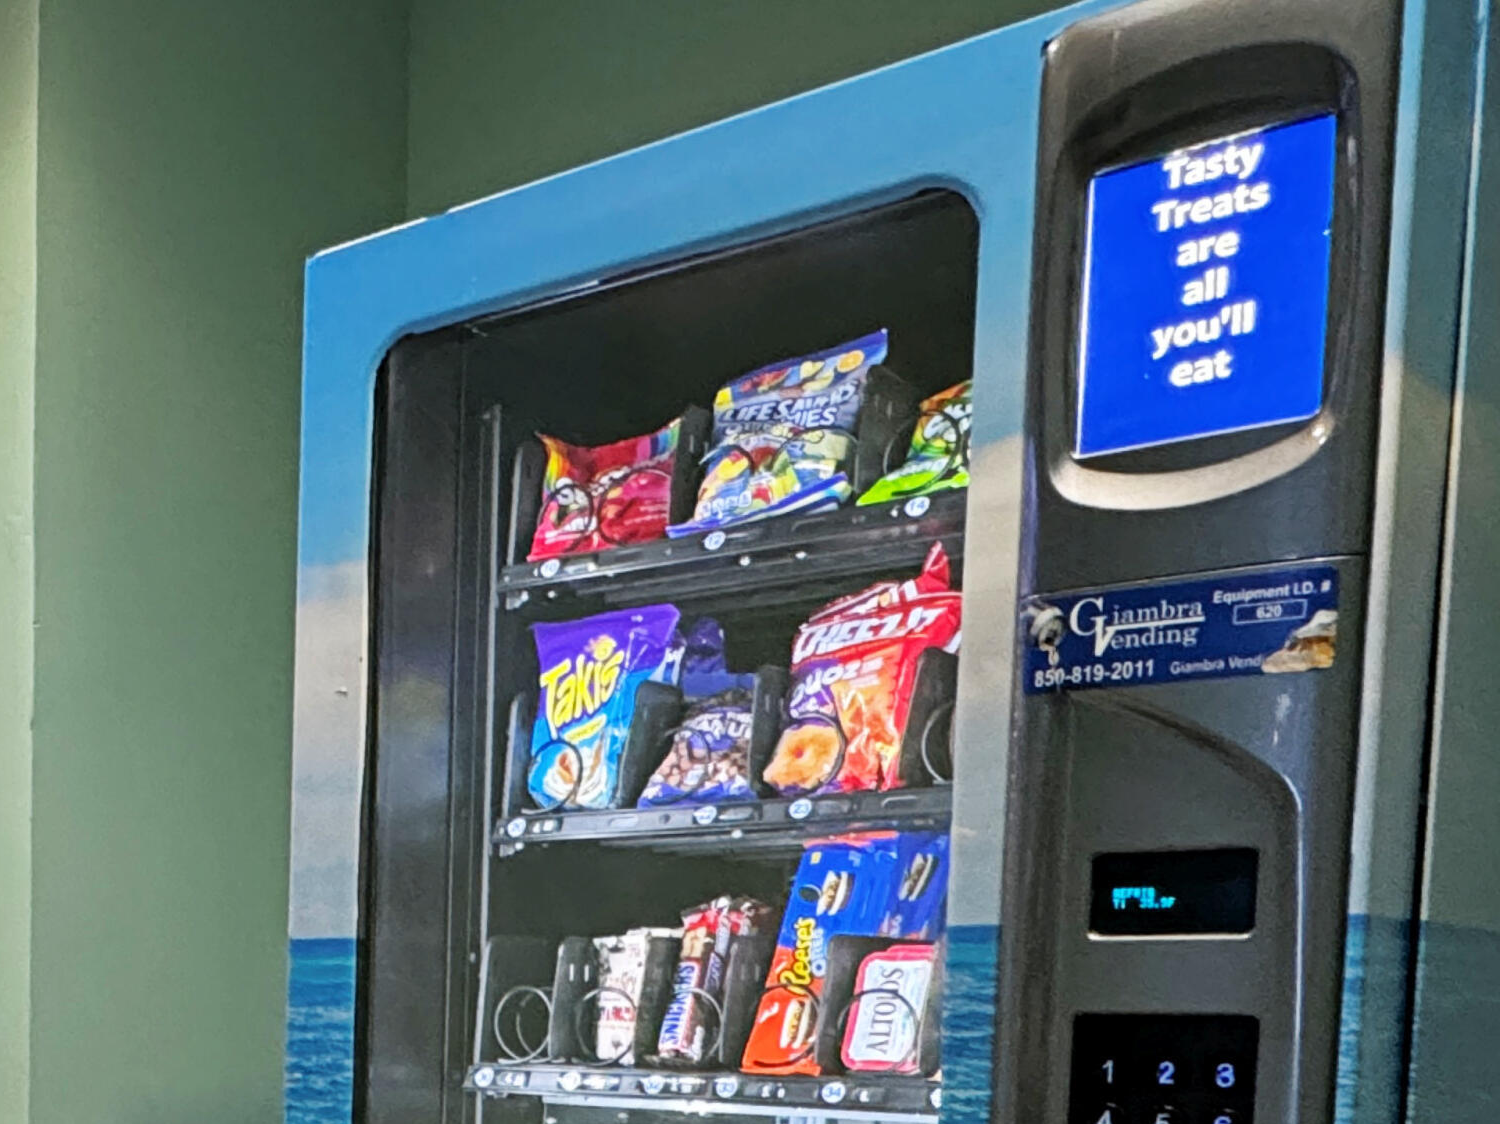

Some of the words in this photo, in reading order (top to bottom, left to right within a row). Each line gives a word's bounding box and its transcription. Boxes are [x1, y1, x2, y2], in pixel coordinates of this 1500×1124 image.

[1162, 142, 1265, 190] Tasty
[1151, 182, 1270, 232] Treats
[1176, 231, 1240, 267] are
[1182, 266, 1230, 306] all
[1151, 300, 1257, 361] you'll
[1169, 350, 1234, 387] eat
[1212, 583, 1290, 607] Equipment
[1069, 597, 1205, 637] Giambra
[1093, 623, 1200, 657] Vending
[1034, 658, 1155, 688] 850-819-2011
[1102, 1060, 1114, 1084] 1
[1158, 1062, 1175, 1085] 2
[1215, 1063, 1235, 1088] 3
